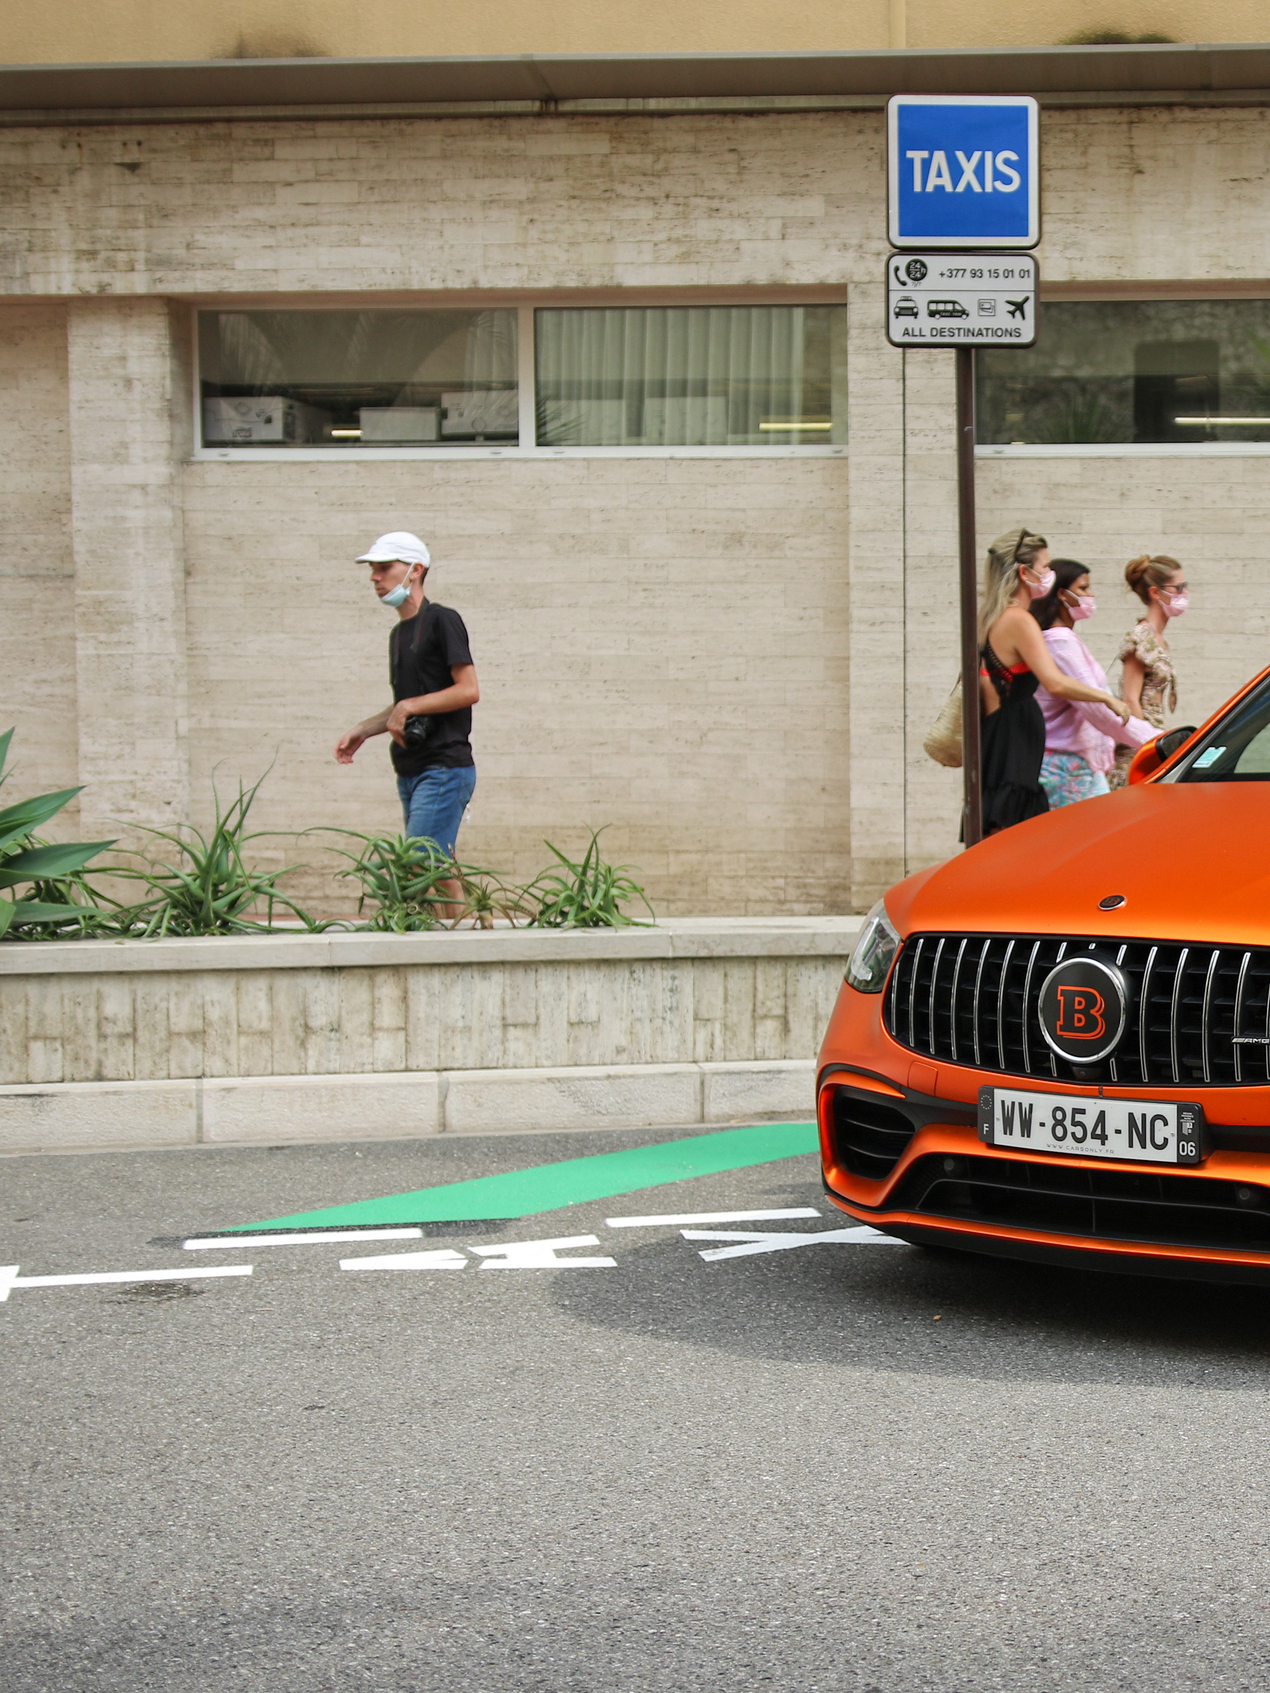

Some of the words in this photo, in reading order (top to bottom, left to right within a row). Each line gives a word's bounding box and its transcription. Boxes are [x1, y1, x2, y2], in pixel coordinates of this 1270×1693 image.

[905, 150, 1021, 192] TAXIS
[909, 261, 921, 269] 24
[939, 268, 967, 279] +377
[970, 268, 984, 279] 93
[987, 268, 1000, 279] 15
[1003, 268, 1014, 279] 01
[1018, 268, 1030, 279] 01
[902, 327, 926, 337] ALL
[930, 327, 1021, 338] DESTINATIONS
[1056, 985, 1105, 1040] B
[983, 1123, 989, 1135] F
[1179, 1141, 1196, 1157] 06
